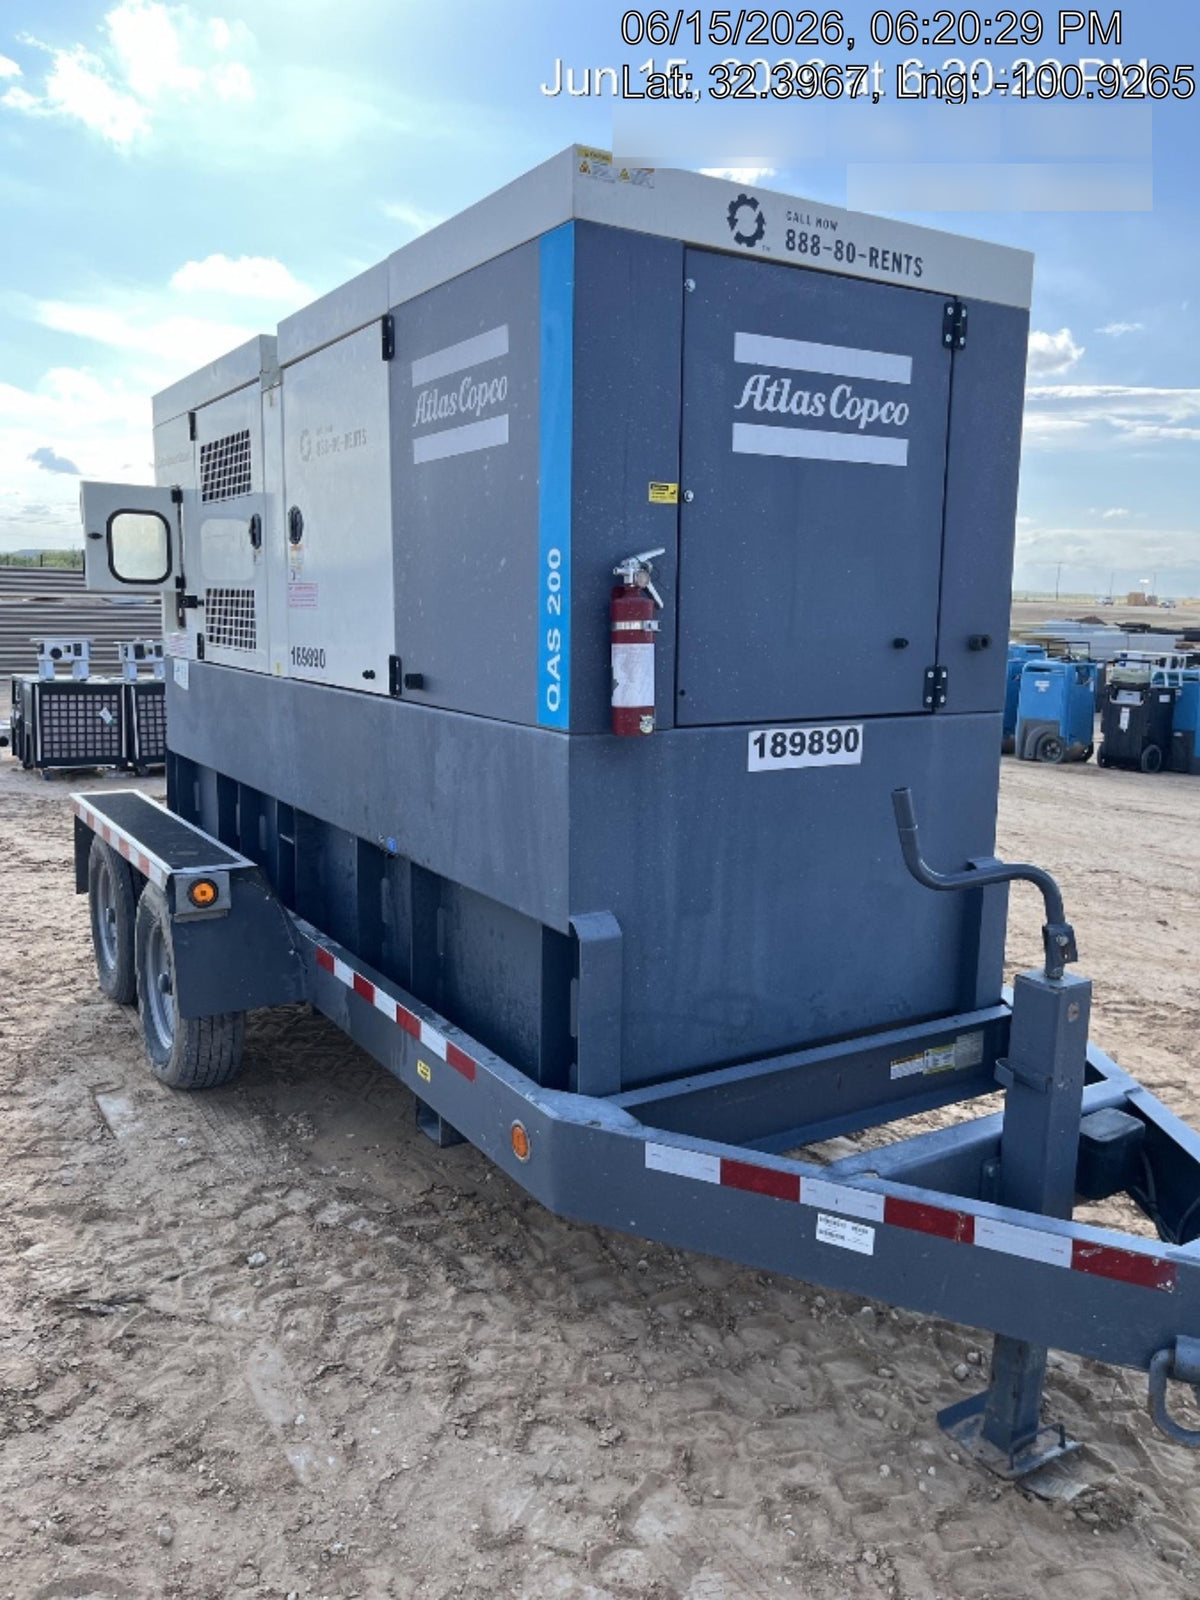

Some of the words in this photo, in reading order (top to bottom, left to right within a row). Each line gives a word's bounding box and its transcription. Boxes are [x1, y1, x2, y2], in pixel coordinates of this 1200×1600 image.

[785, 228, 924, 278] 888-80-RENTS
[412, 387, 457, 428] Atlas
[458, 375, 508, 418] Copco
[734, 373, 826, 417] Atlas
[829, 384, 910, 430] Copco
[546, 548, 562, 616] 200
[546, 628, 562, 712] QAS
[753, 727, 860, 759] 189890
